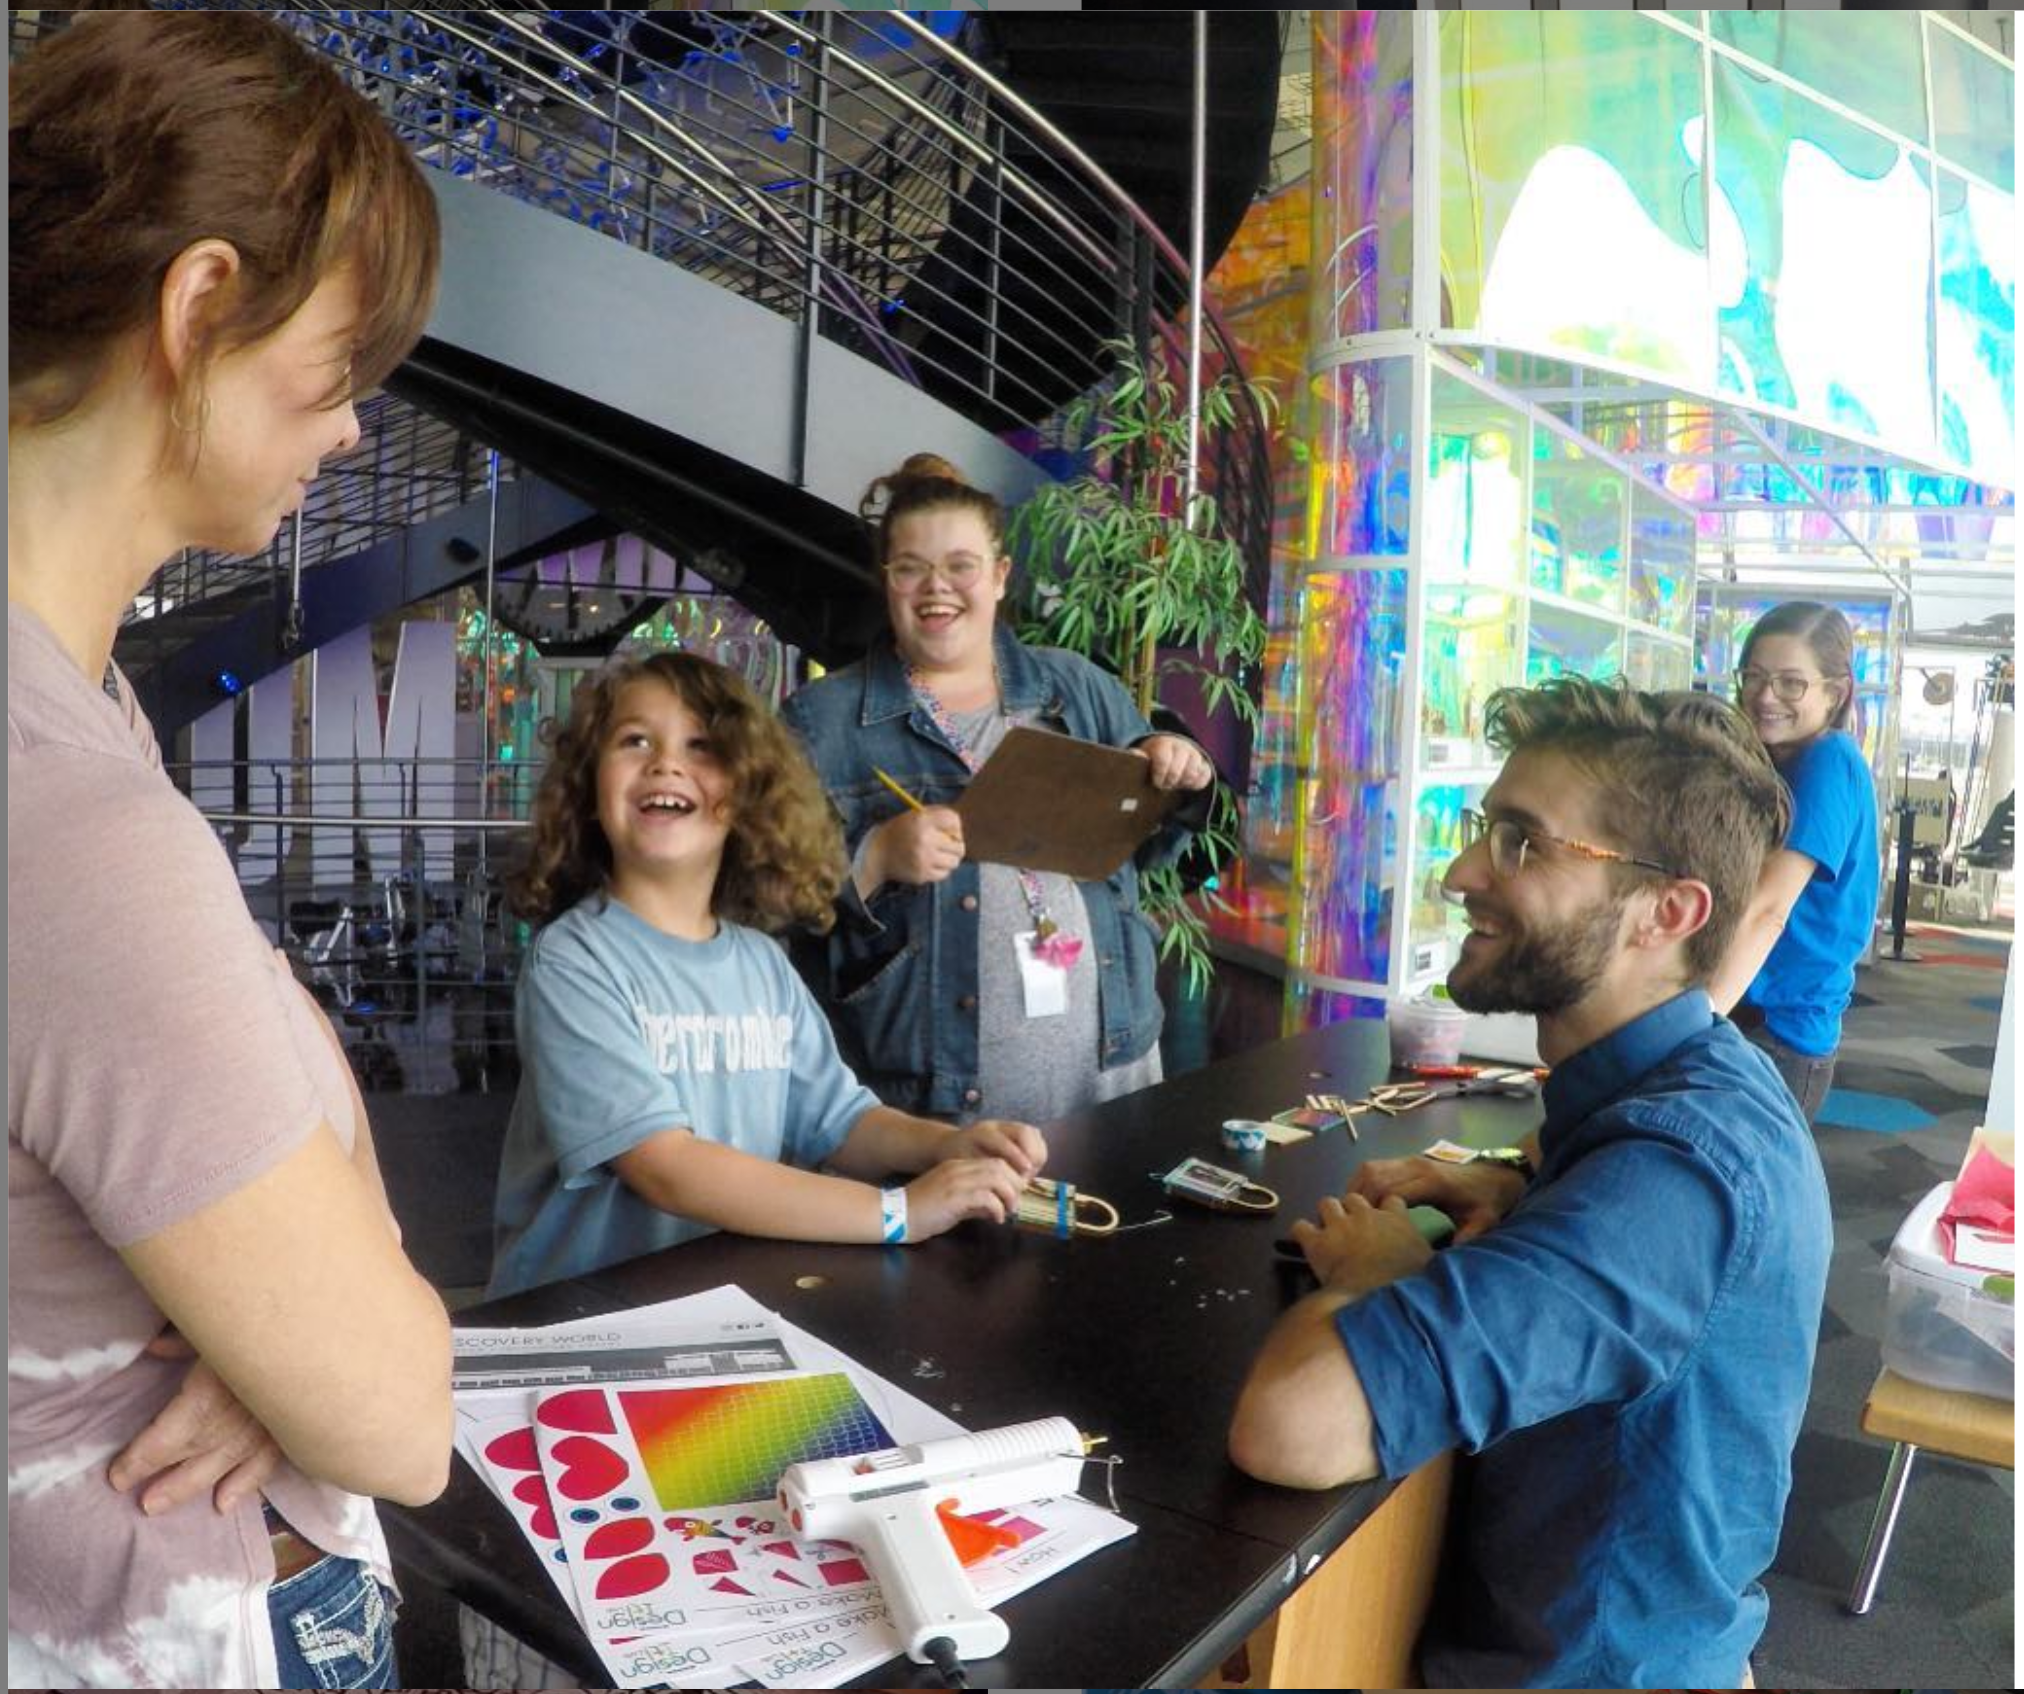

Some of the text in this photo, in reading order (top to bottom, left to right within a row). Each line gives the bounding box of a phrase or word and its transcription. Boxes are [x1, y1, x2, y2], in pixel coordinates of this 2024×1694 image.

[455, 1336, 543, 1347] SCOVERY
[552, 1332, 622, 1344] WORLD
[597, 1608, 686, 1629] Design
[747, 1604, 789, 1617] Fish
[768, 1628, 811, 1646] Fish
[620, 1646, 712, 1678] Design
[766, 1641, 848, 1680] Design
